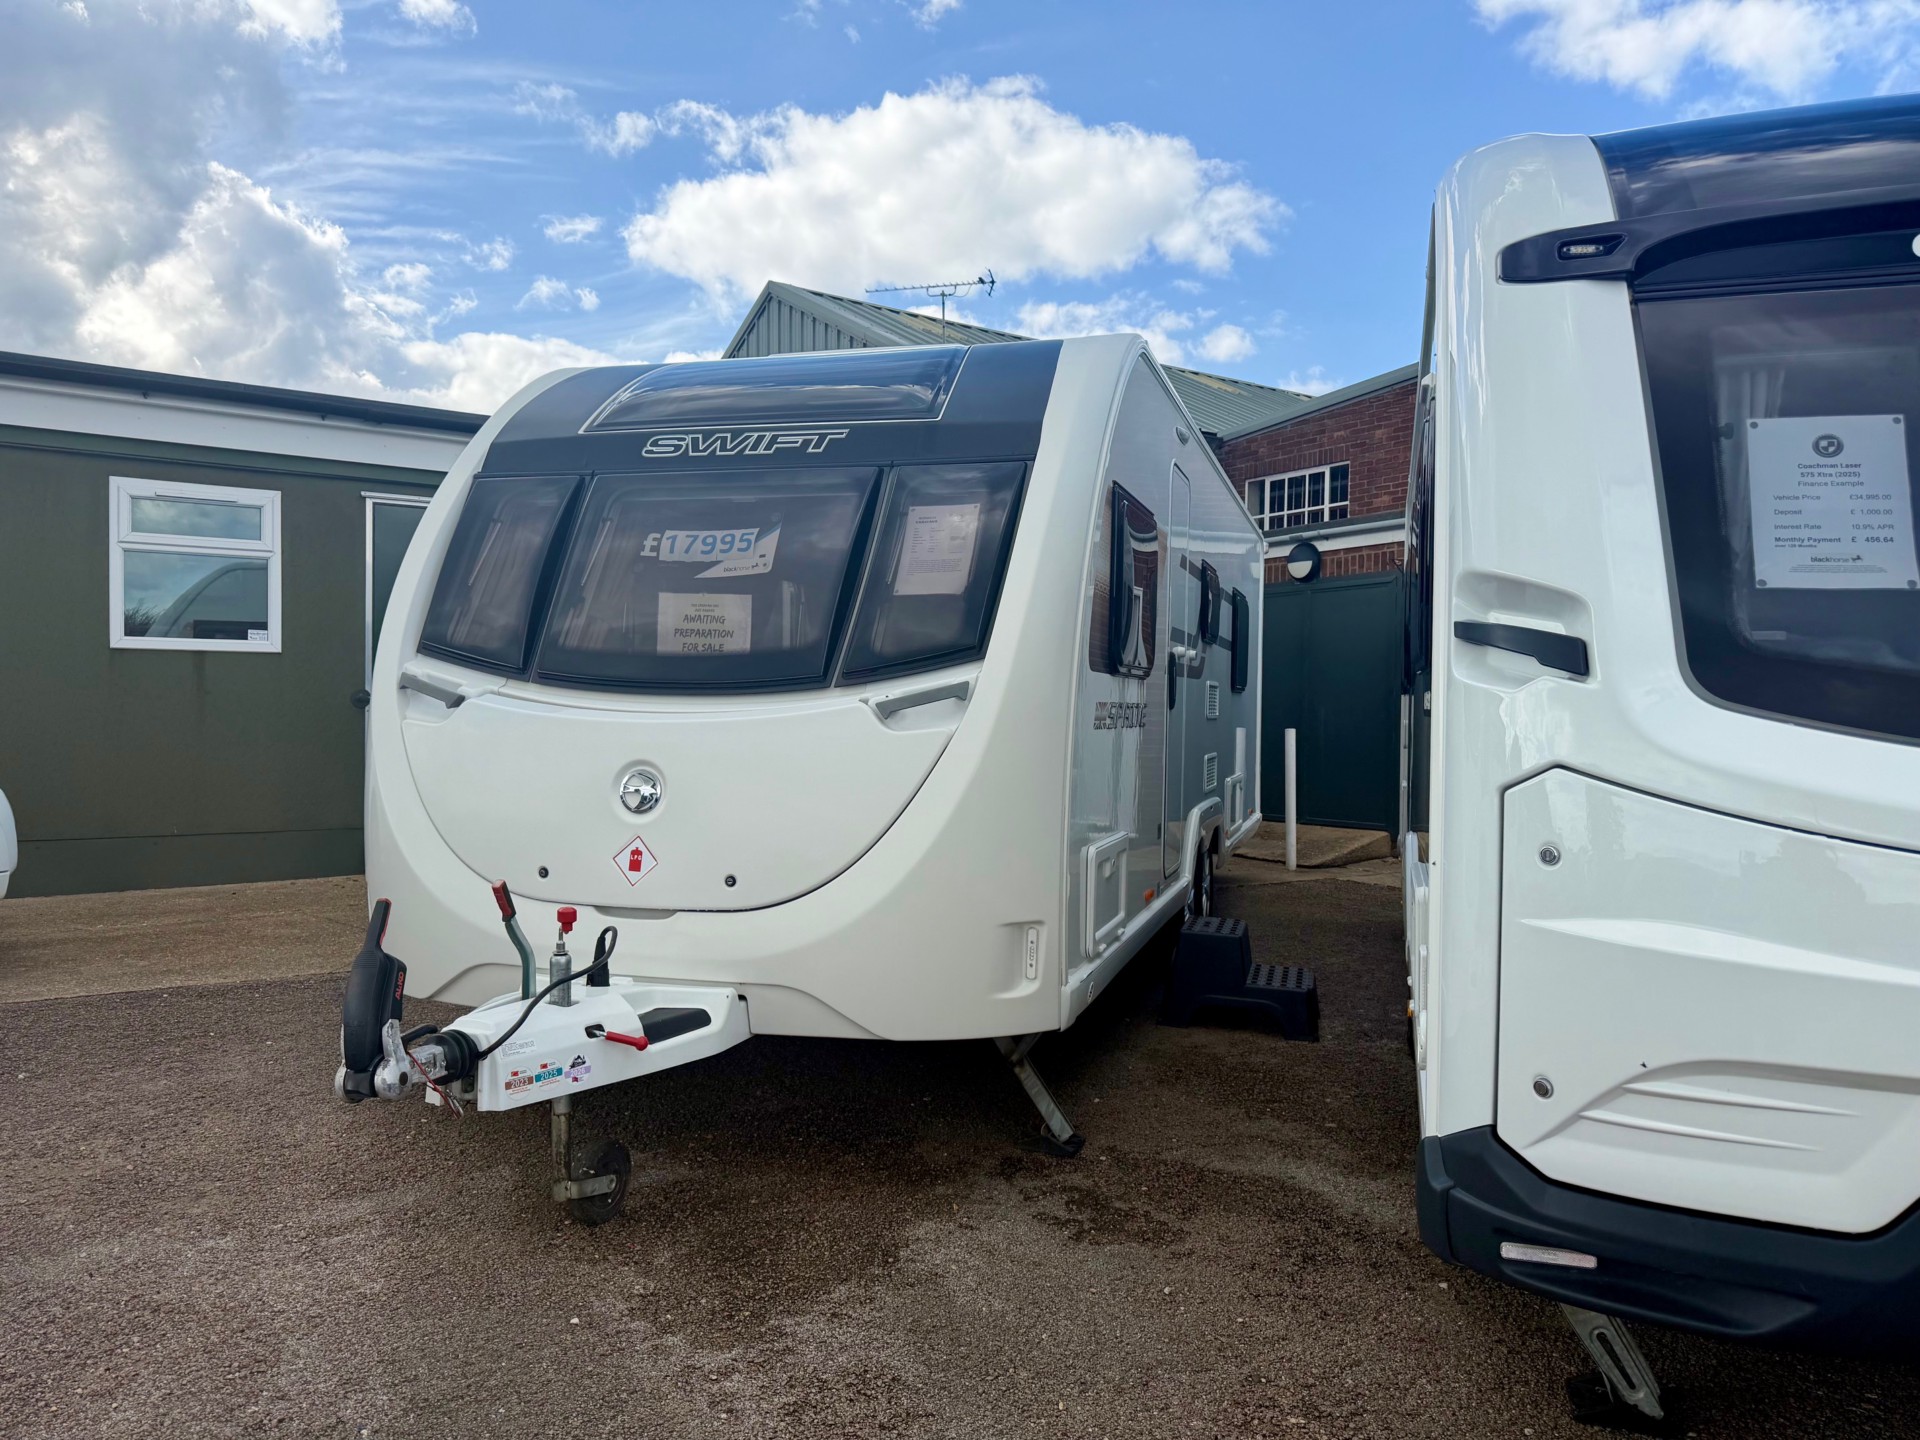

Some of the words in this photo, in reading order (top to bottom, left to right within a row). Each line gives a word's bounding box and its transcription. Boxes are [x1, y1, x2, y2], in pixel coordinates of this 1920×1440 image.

[641, 428, 850, 457] SWIFT
[1835, 471, 1861, 479] (2025)
[1830, 480, 1865, 488] Example
[1774, 536, 1805, 544] Monthly
[1807, 536, 1841, 544] Payment
[682, 613, 727, 625] AWAITING
[673, 627, 735, 639] PREPARATION
[681, 642, 700, 653] FOR
[701, 642, 725, 653] SALE
[540, 1070, 558, 1080] 2025
[510, 1078, 529, 1089] 2023
